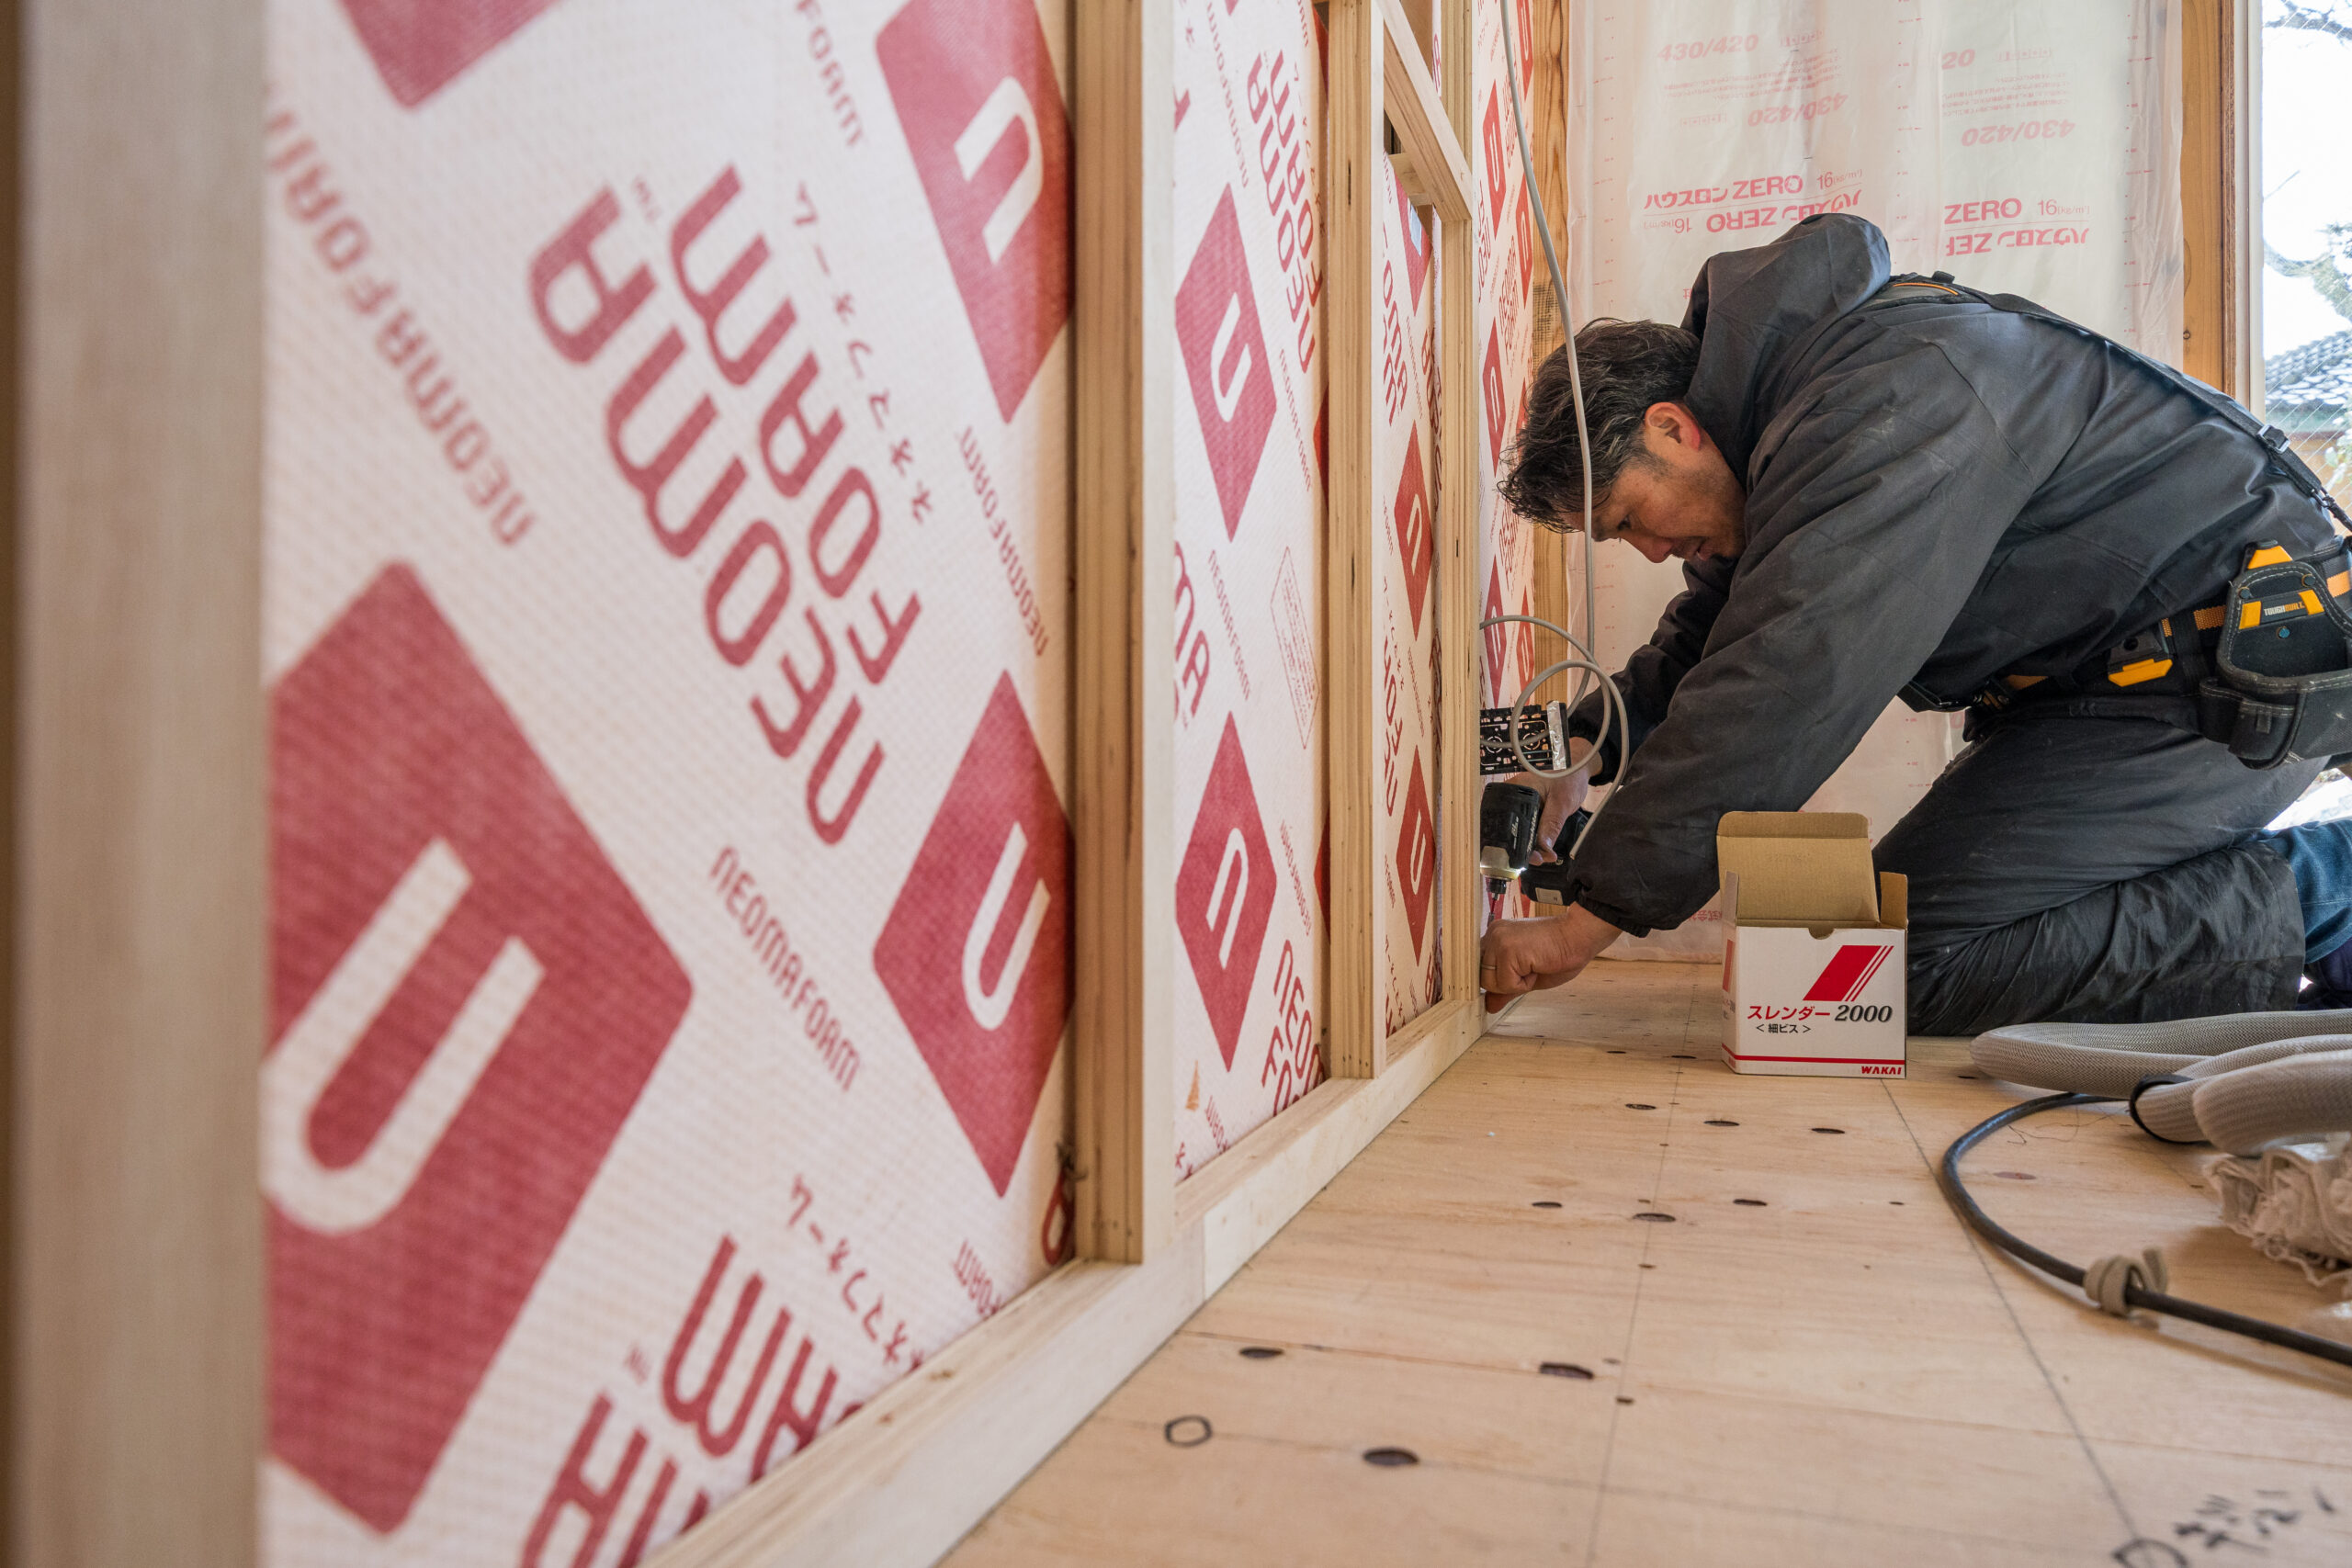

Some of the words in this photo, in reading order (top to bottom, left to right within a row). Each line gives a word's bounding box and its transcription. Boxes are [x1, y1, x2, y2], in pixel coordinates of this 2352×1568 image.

[1657, 34, 1758, 62] 430/420
[1962, 119, 2076, 147] 430/420
[1270, 48, 1325, 309] FOAM
[1732, 175, 1804, 199] ZERO
[1246, 52, 1316, 374] NEOMA
[1706, 207, 1779, 233] ZERO
[1944, 197, 2023, 224] ZERO
[1997, 227, 2090, 248] ハウスロン
[1383, 260, 1408, 412] OMA
[671, 164, 922, 684] FOAM
[526, 186, 885, 845] NEOMA
[709, 845, 862, 1092] NEOMAFOAM
[1747, 1005, 1831, 1021] スレンダー
[1834, 1004, 1893, 1022] 2000
[1860, 1066, 1903, 1076] WAKAI
